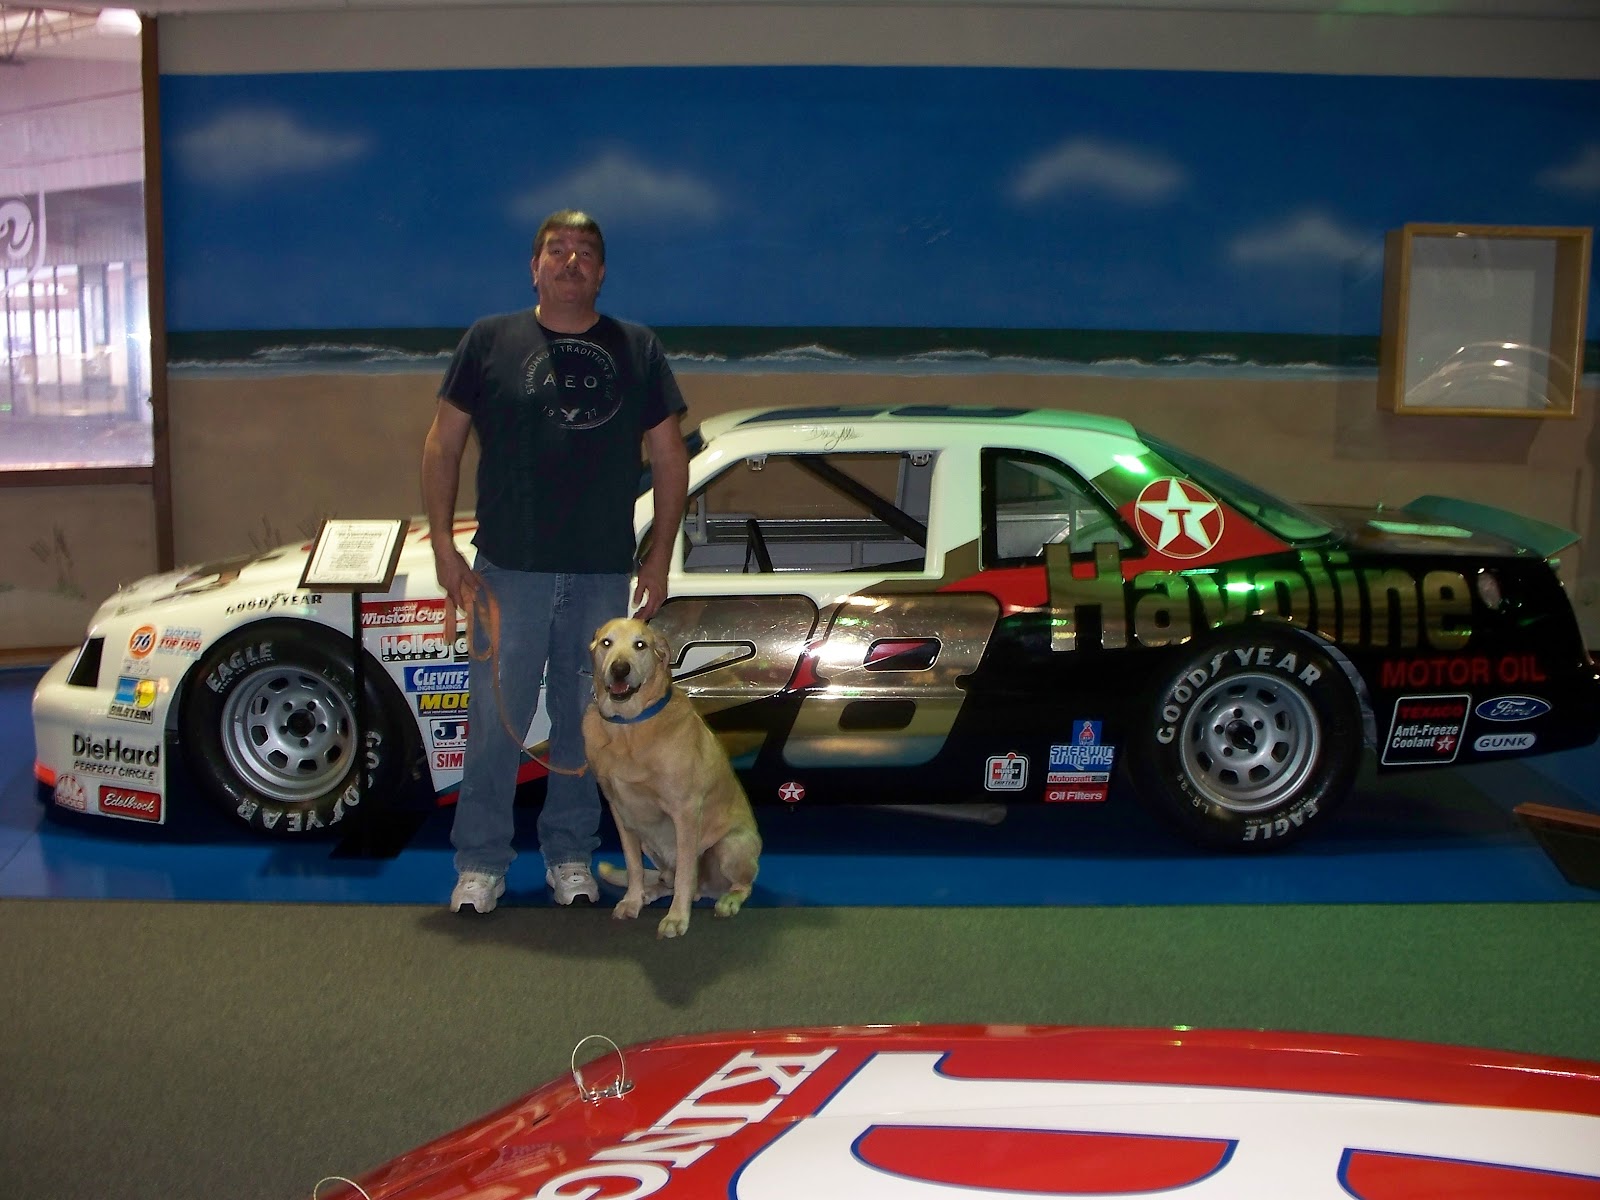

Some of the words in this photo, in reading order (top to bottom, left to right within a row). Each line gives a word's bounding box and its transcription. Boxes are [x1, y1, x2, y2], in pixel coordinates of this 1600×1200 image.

[1043, 542, 1473, 651] Havoline
[362, 611, 416, 625] Winston
[416, 609, 446, 624] Cup
[132, 632, 154, 652] 76
[382, 634, 449, 658] Holley
[206, 643, 272, 693] EAGLE
[1381, 659, 1490, 689] MOTOR
[1499, 656, 1547, 684] OIL
[109, 705, 152, 721] BILSTEIN
[1491, 700, 1536, 716] Ford
[1394, 725, 1459, 737] Anti-Freeze
[72, 732, 160, 768] DieHard
[1392, 737, 1436, 748] Coolant
[1479, 737, 1528, 749] GUNK
[74, 760, 116, 776] PERFECT
[118, 768, 155, 781] CIRCLE
[104, 793, 155, 813] Edelbrock
[1049, 791, 1066, 801] Oil
[1067, 791, 1103, 800] Filters
[1243, 798, 1319, 841] EAGLE
